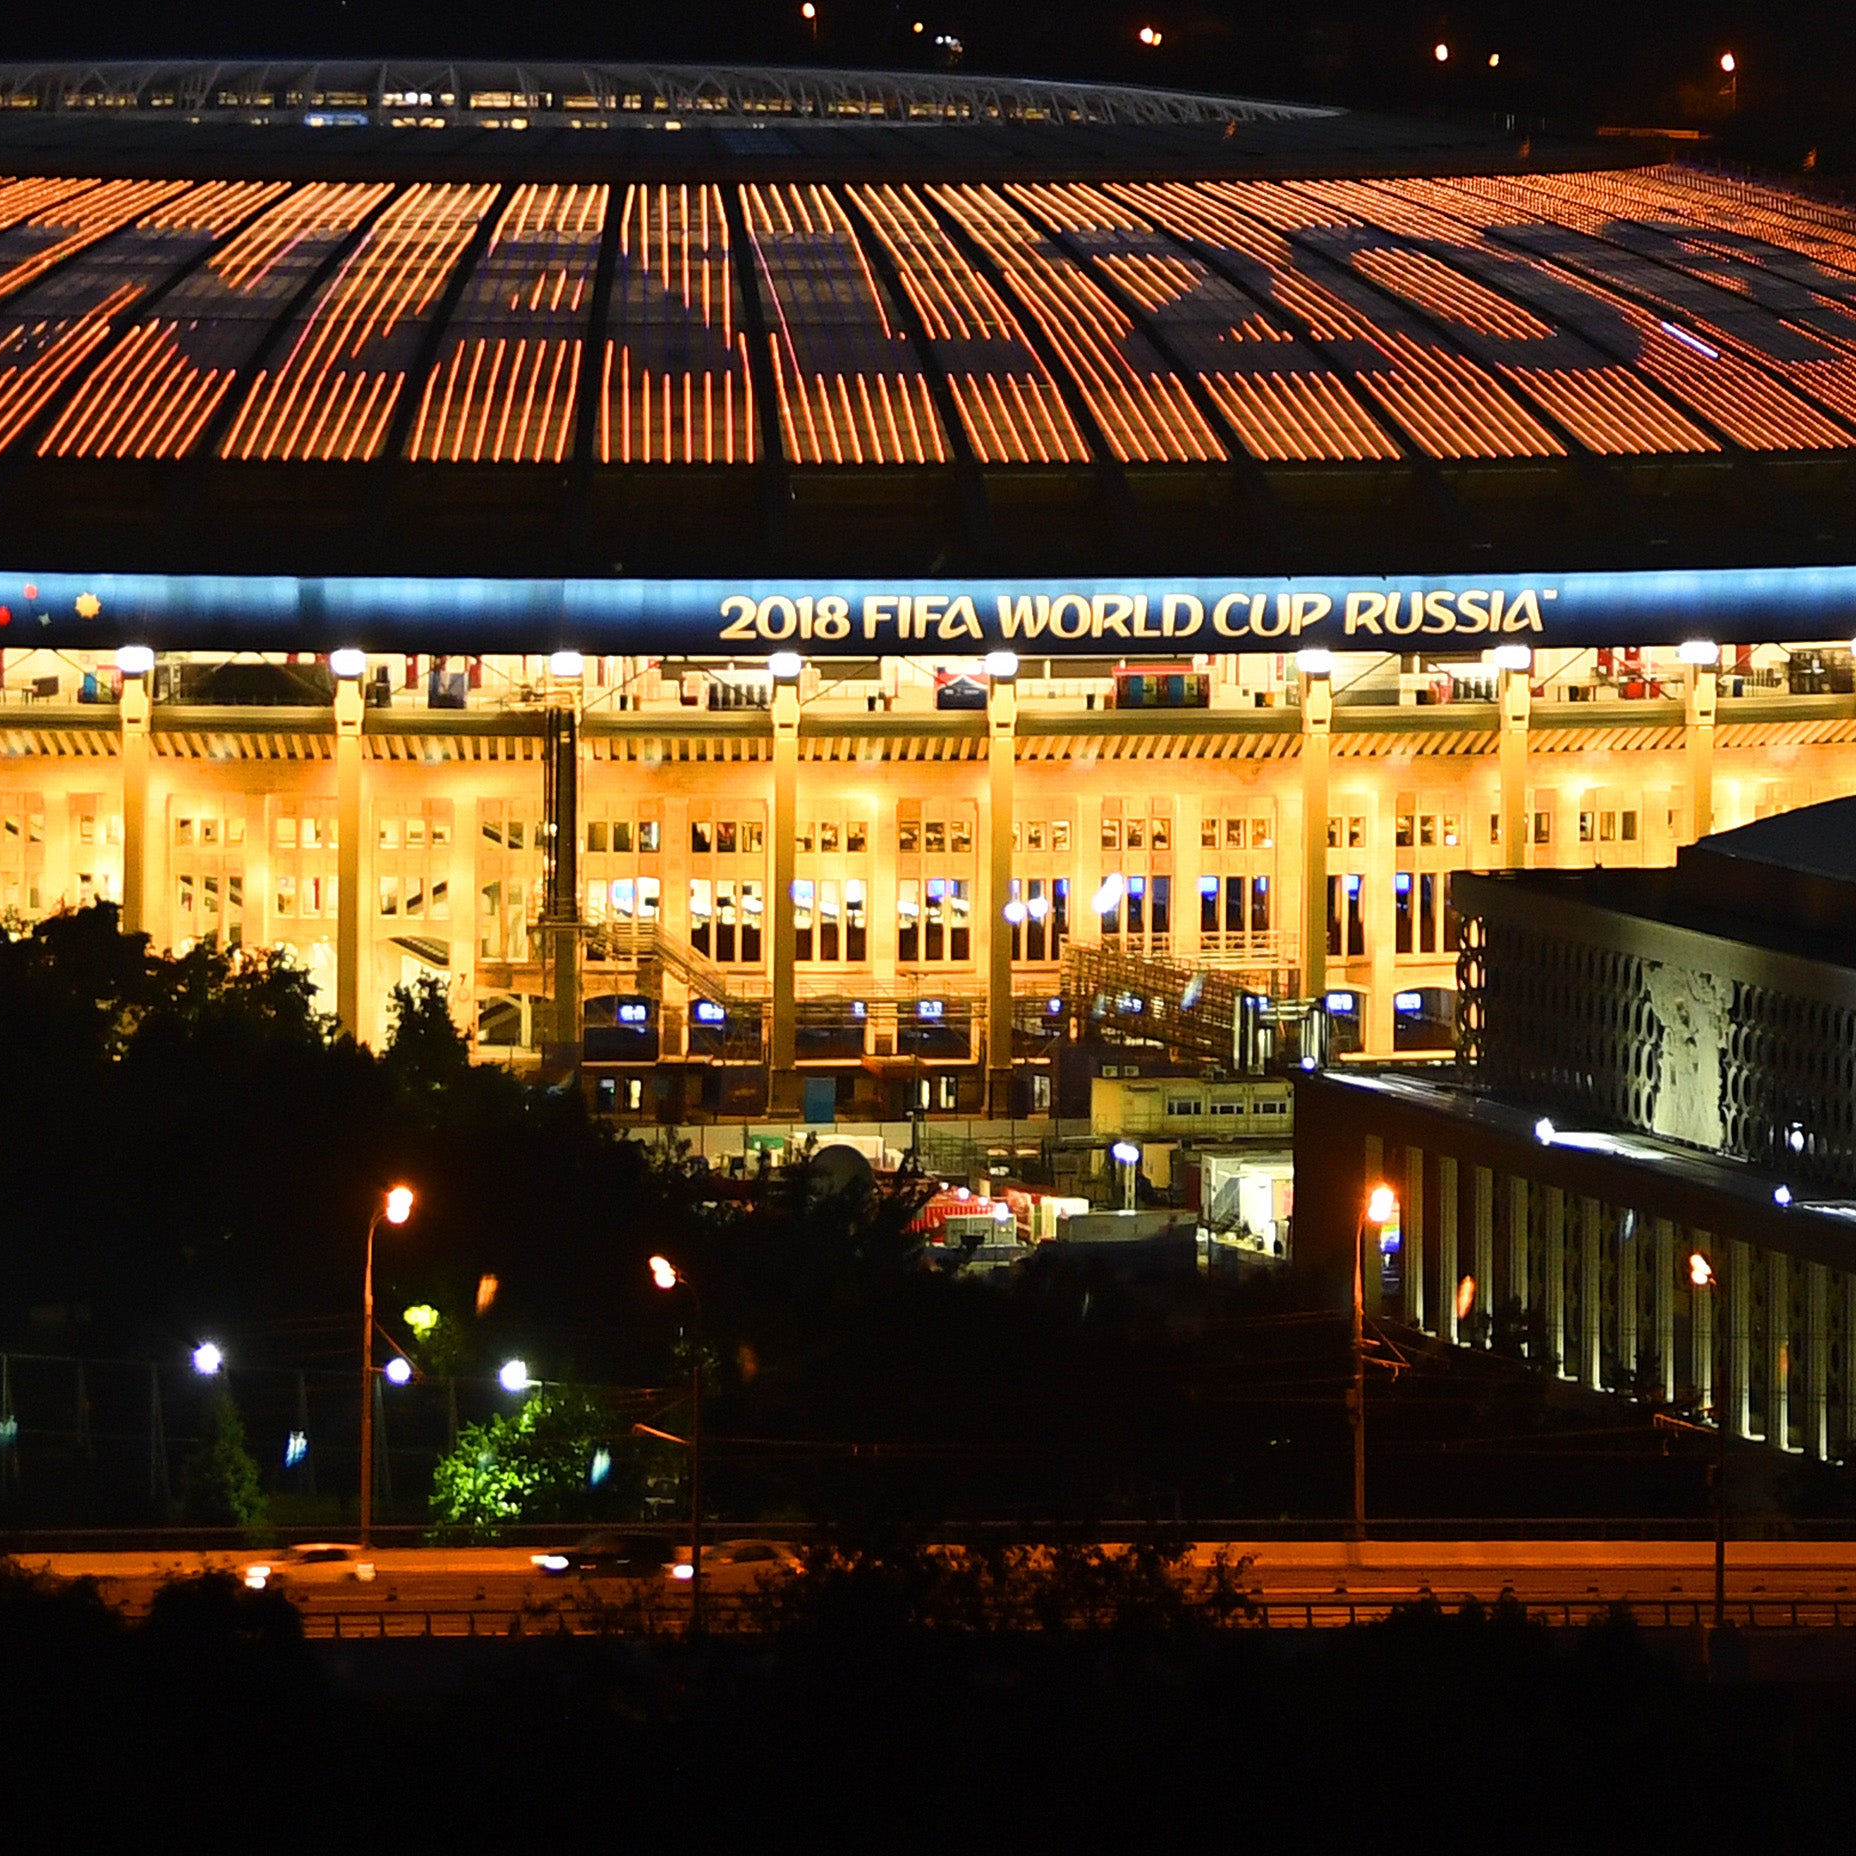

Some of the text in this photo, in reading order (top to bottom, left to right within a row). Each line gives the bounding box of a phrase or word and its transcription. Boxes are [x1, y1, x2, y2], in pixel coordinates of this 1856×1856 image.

[719, 594, 851, 640] 2018
[862, 594, 984, 640] FIFA
[996, 592, 1205, 640] WORLD
[1211, 592, 1332, 637] CUP
